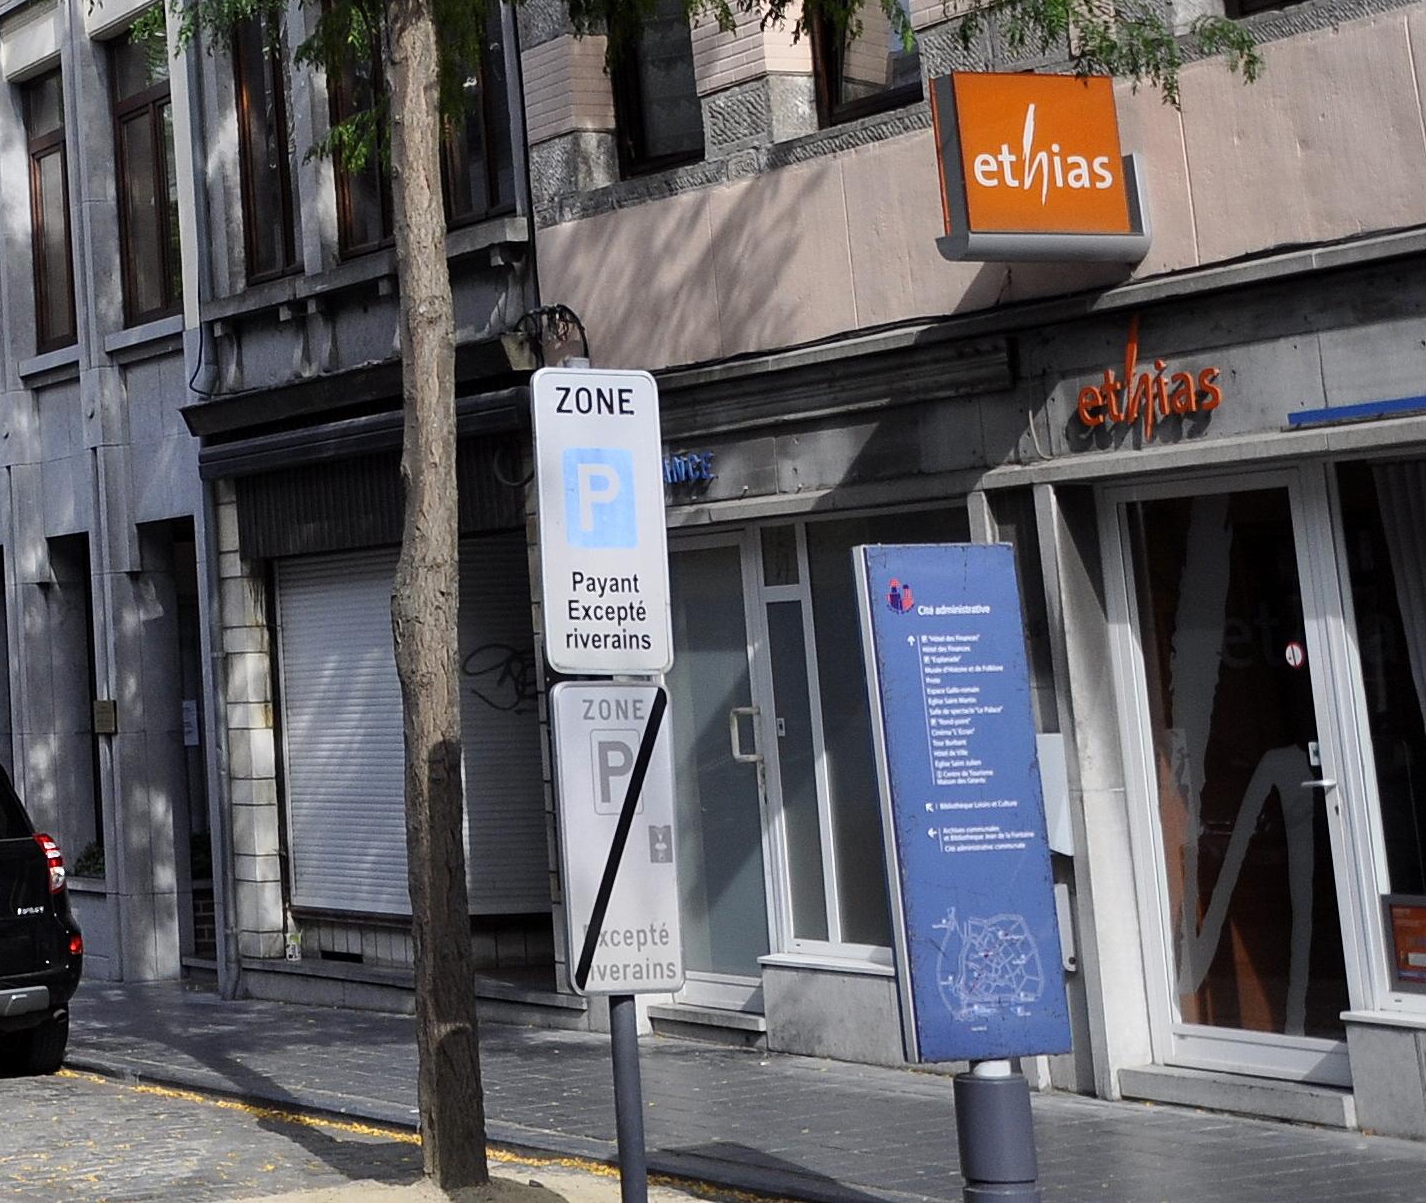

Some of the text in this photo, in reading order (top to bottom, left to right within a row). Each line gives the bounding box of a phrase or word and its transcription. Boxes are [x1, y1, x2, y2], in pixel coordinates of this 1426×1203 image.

[974, 103, 1113, 205] ethias
[1078, 315, 1222, 443] ethias
[556, 387, 635, 415] ZONE
[572, 571, 639, 598] Payant
[568, 600, 646, 627] Excepté
[917, 604, 991, 616] Cité administrative
[566, 627, 652, 650] riverains
[582, 699, 645, 721] ZONE
[590, 958, 677, 981] iverains
